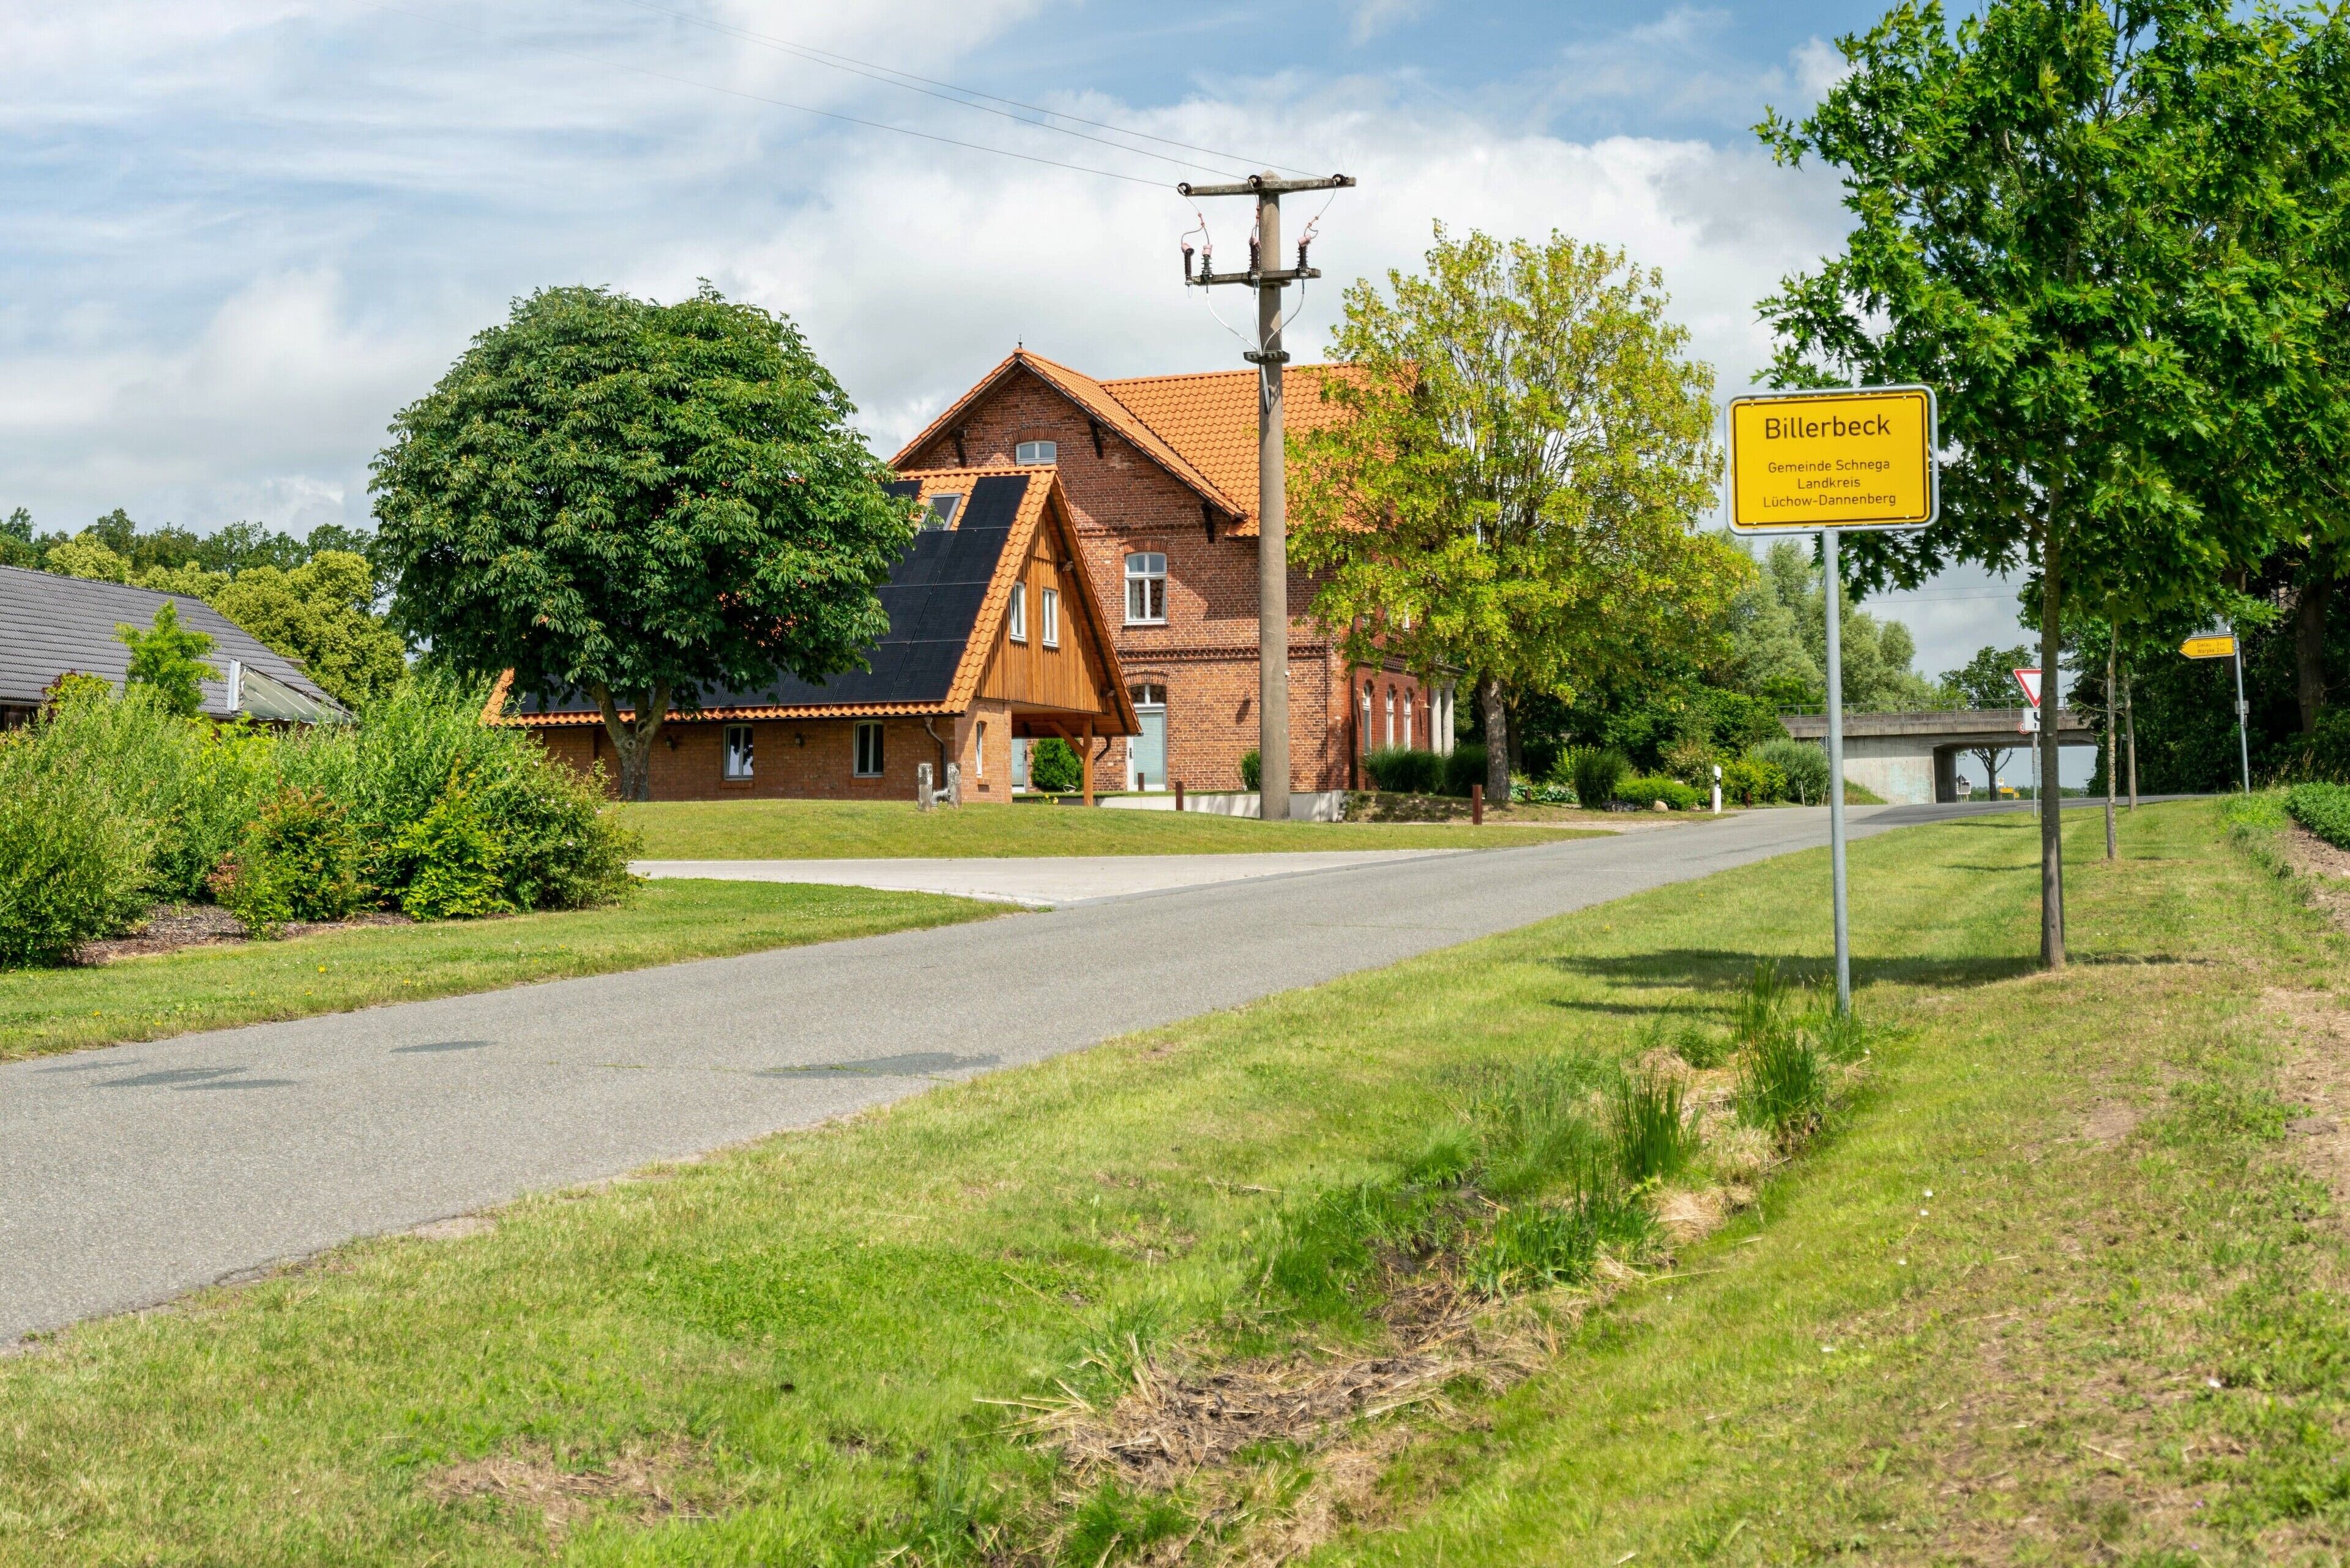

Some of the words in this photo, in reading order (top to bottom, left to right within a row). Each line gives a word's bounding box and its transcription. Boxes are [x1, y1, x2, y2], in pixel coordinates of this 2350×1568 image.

[1766, 414, 1891, 439] Billerbeck
[1768, 461, 1832, 473] Gemeinde
[1836, 459, 1890, 472] Schnega
[1798, 477, 1860, 489] Landkreis
[1764, 493, 1896, 508] Lüchow-Dannenberg
